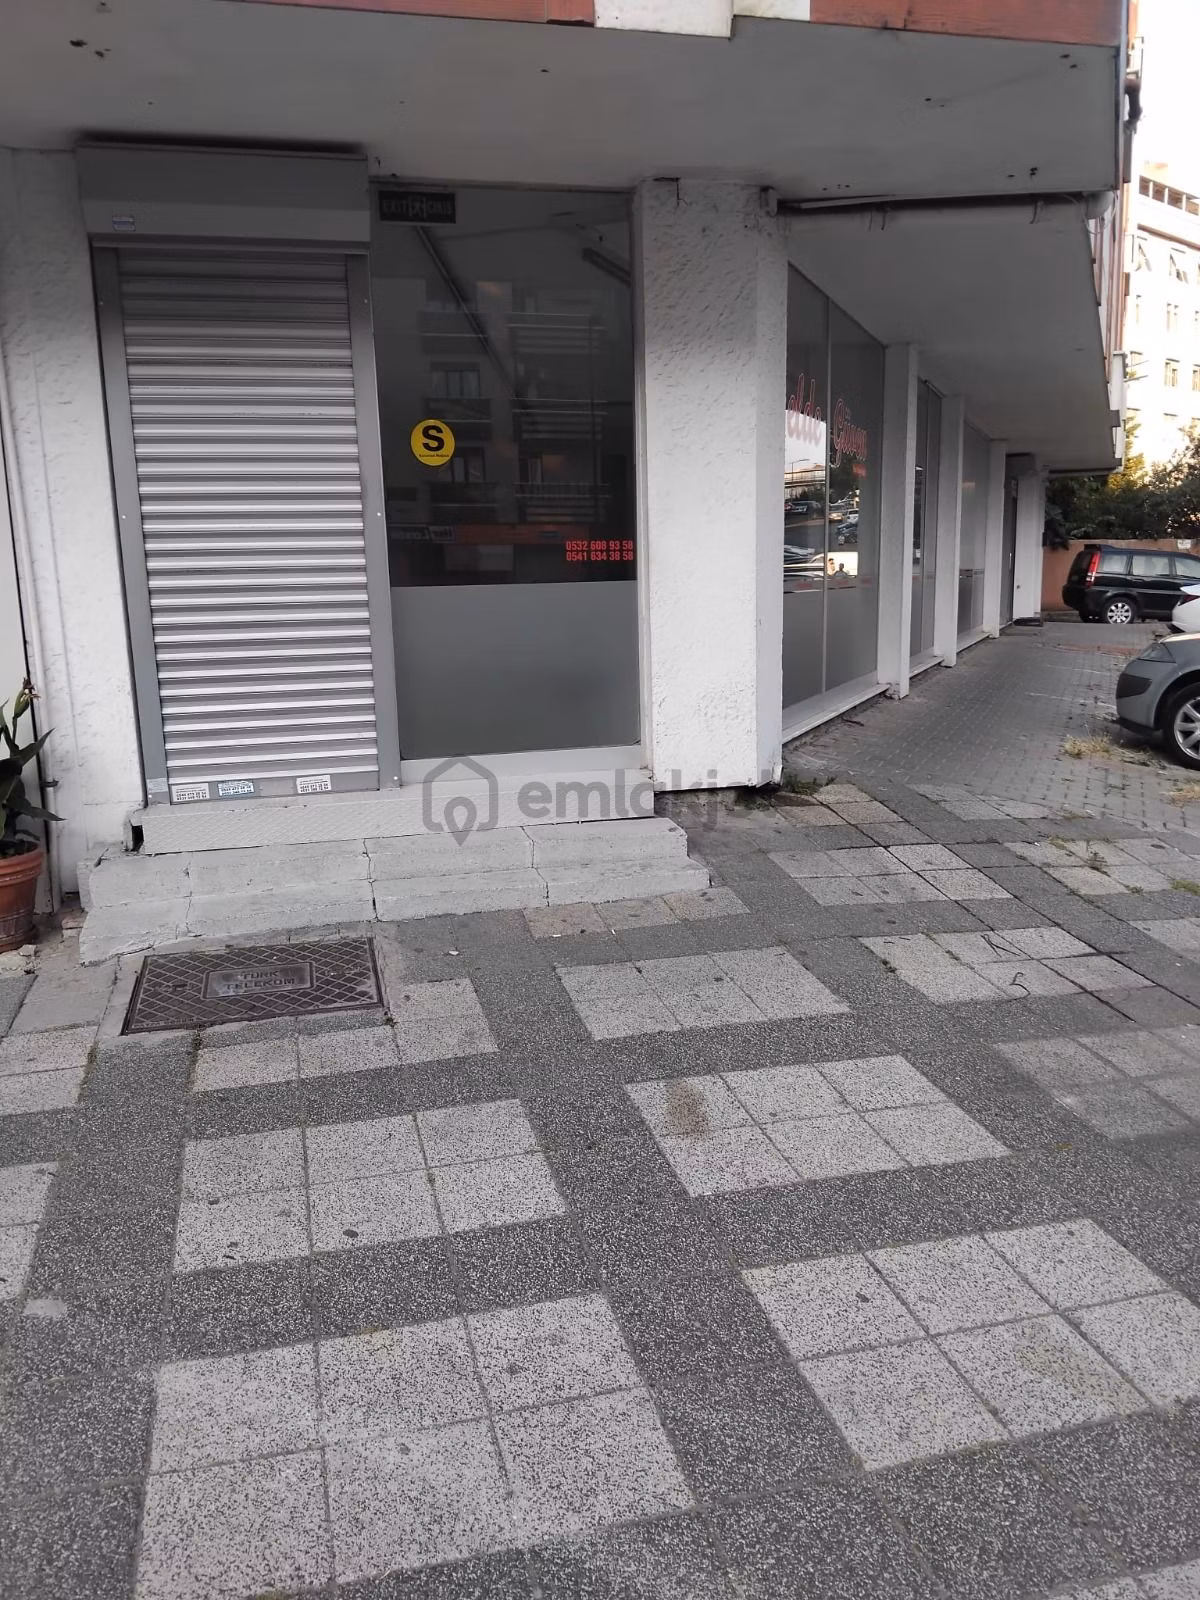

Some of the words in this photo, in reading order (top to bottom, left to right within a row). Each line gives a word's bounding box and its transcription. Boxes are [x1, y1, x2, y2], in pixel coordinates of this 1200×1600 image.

[422, 424, 444, 452] S
[566, 540, 588, 551] 0532
[590, 540, 607, 551] 608
[609, 540, 620, 551] 93
[622, 540, 633, 551] 58
[566, 551, 587, 561] 0541
[609, 551, 620, 561] 38
[622, 551, 633, 561] 58
[223, 976, 296, 991] TELEKOM
